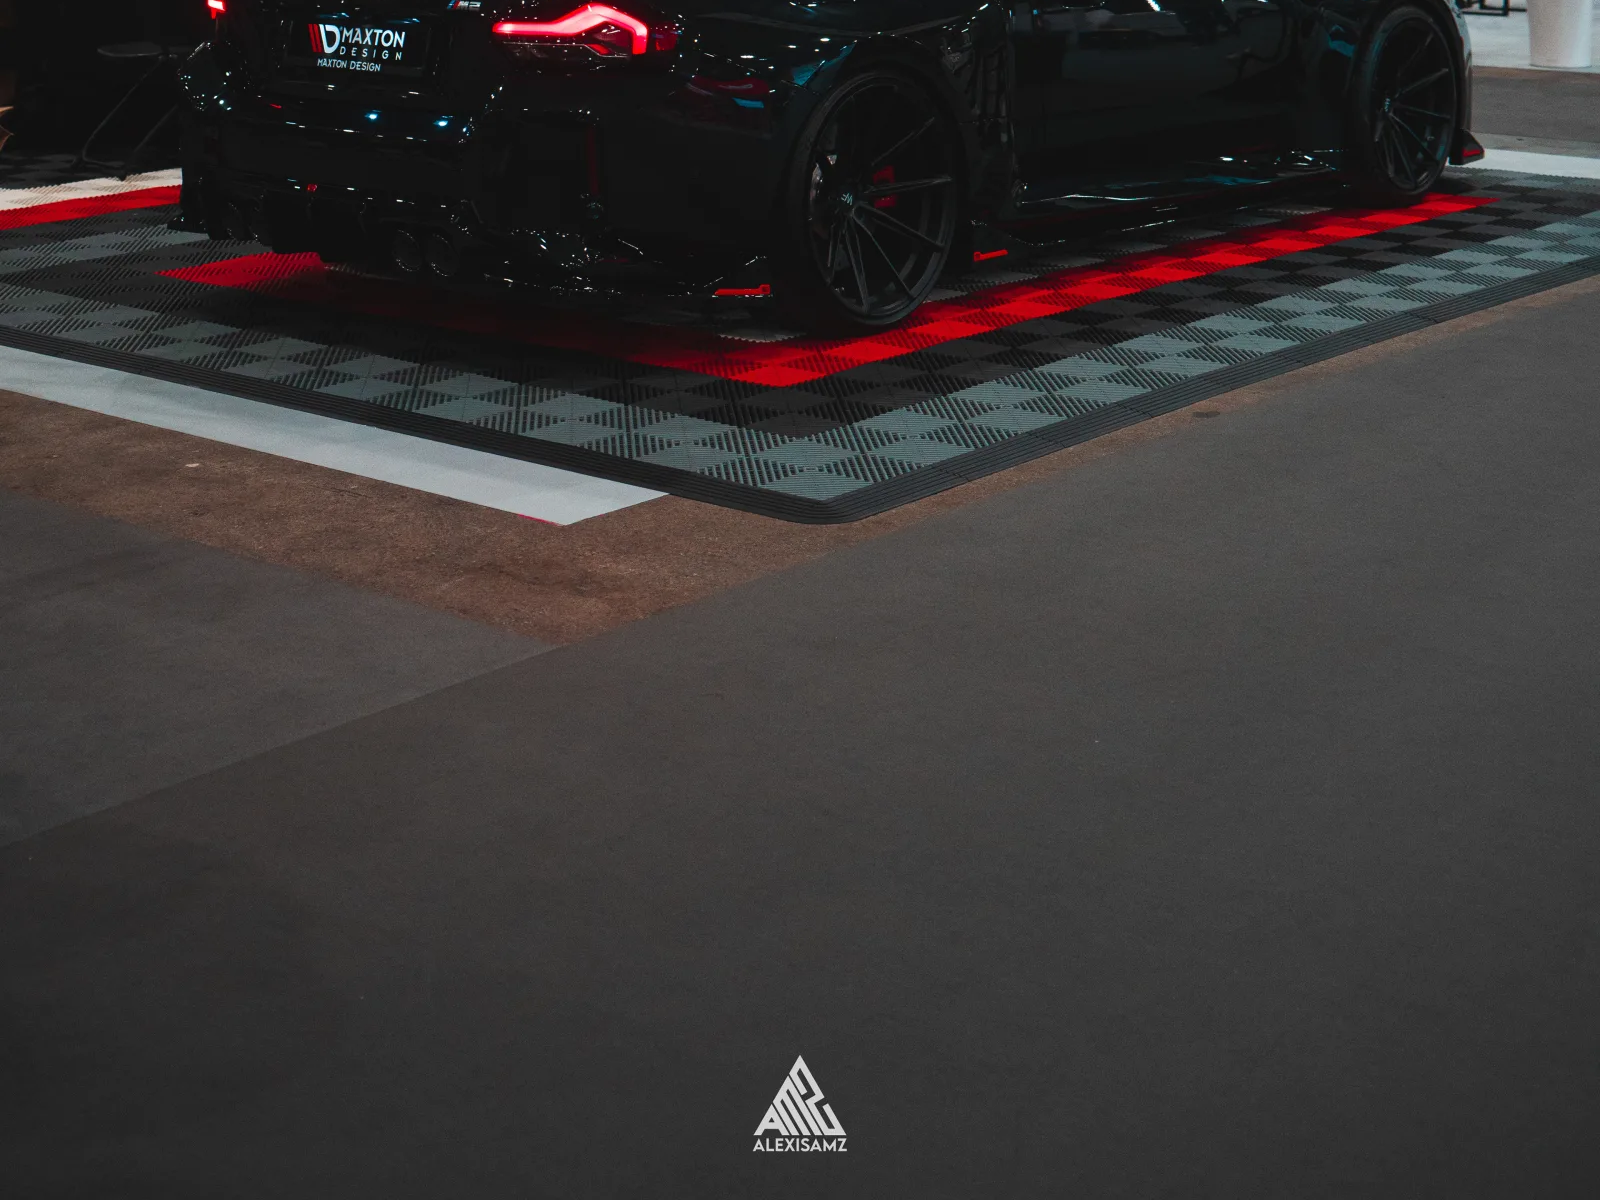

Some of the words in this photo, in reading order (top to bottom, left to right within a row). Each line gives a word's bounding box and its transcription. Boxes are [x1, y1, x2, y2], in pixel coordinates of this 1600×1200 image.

[341, 26, 406, 49] MAXTON
[340, 46, 402, 61] DESIGN
[317, 58, 347, 69] MAXTON
[349, 60, 381, 73] DESIGN
